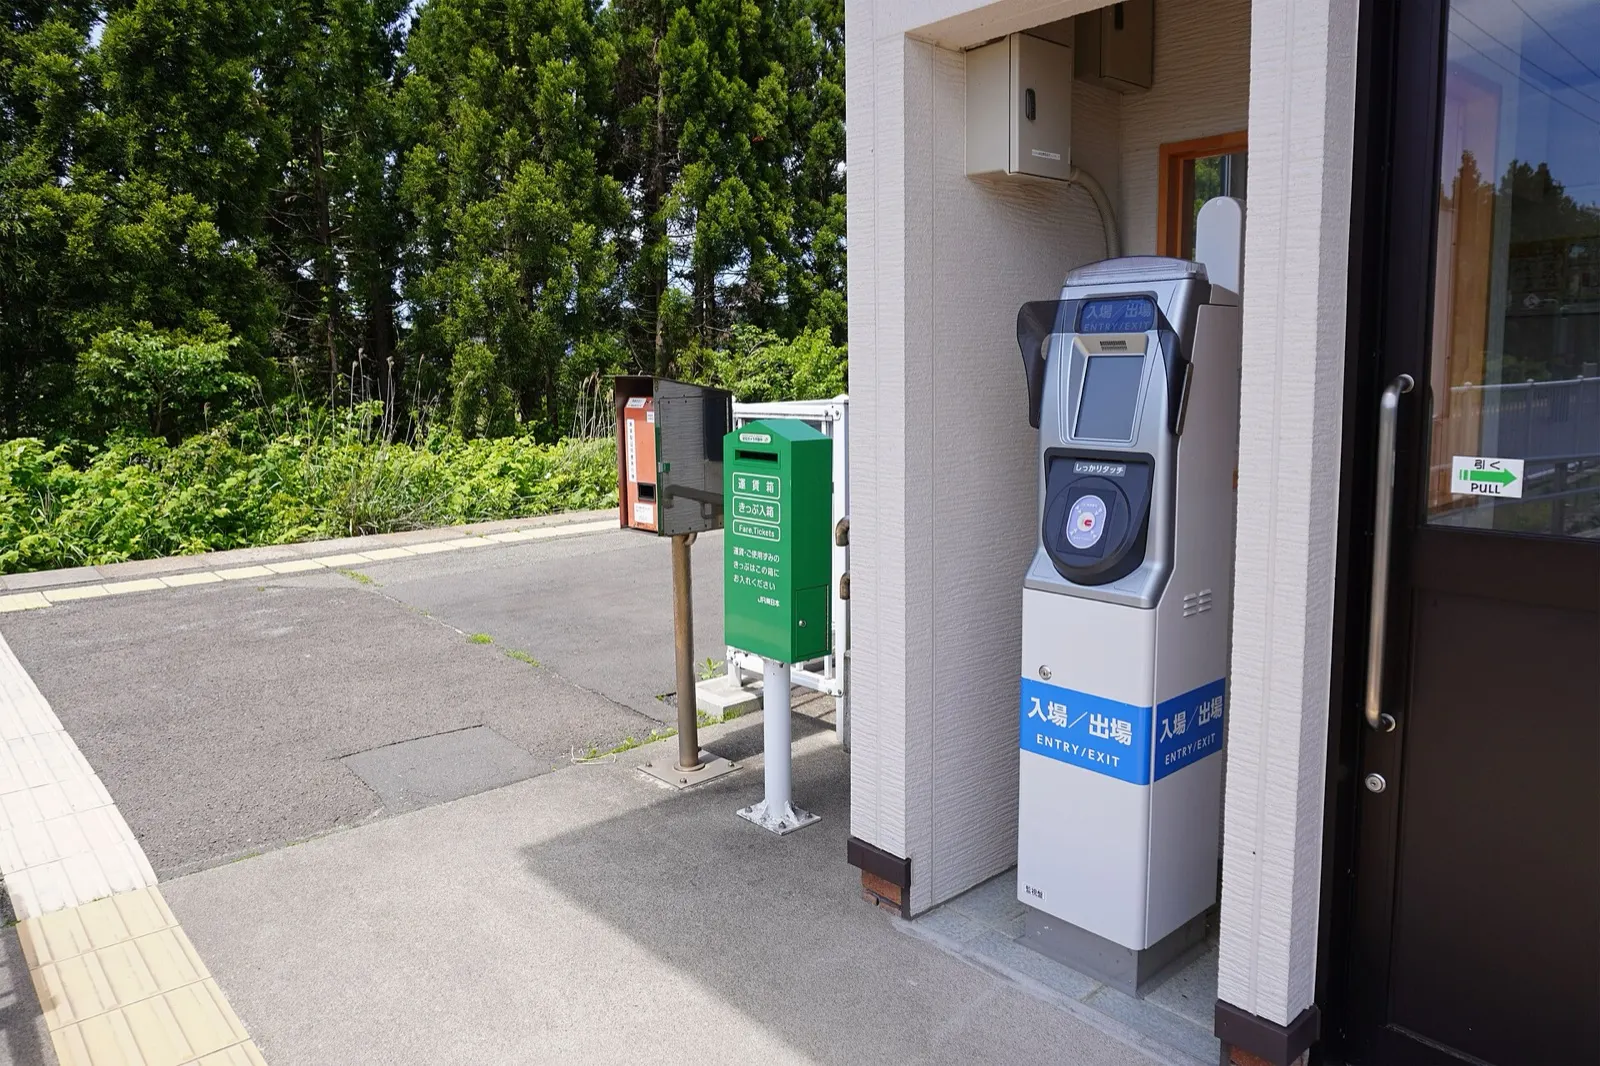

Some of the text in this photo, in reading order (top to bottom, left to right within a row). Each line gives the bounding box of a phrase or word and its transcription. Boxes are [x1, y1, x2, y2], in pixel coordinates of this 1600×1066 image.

[1086, 301, 1152, 319] 入場／出場
[1084, 320, 1150, 332] ENTRY/EXIT
[1075, 463, 1124, 474] しっかりタッチ
[1474, 459, 1501, 470] 引く
[737, 477, 775, 494] 運賃箱
[1470, 482, 1501, 494] PULL
[738, 502, 775, 518] きっぷ入箱
[733, 560, 780, 578] きっぷはこの箱に
[733, 574, 776, 591] お入れください
[1027, 696, 1133, 746] 入場／出場
[1159, 695, 1223, 744] 入場／出場
[1036, 733, 1121, 768] ENTRY/EXIT
[1165, 732, 1216, 766] ENTRY/EXIT
